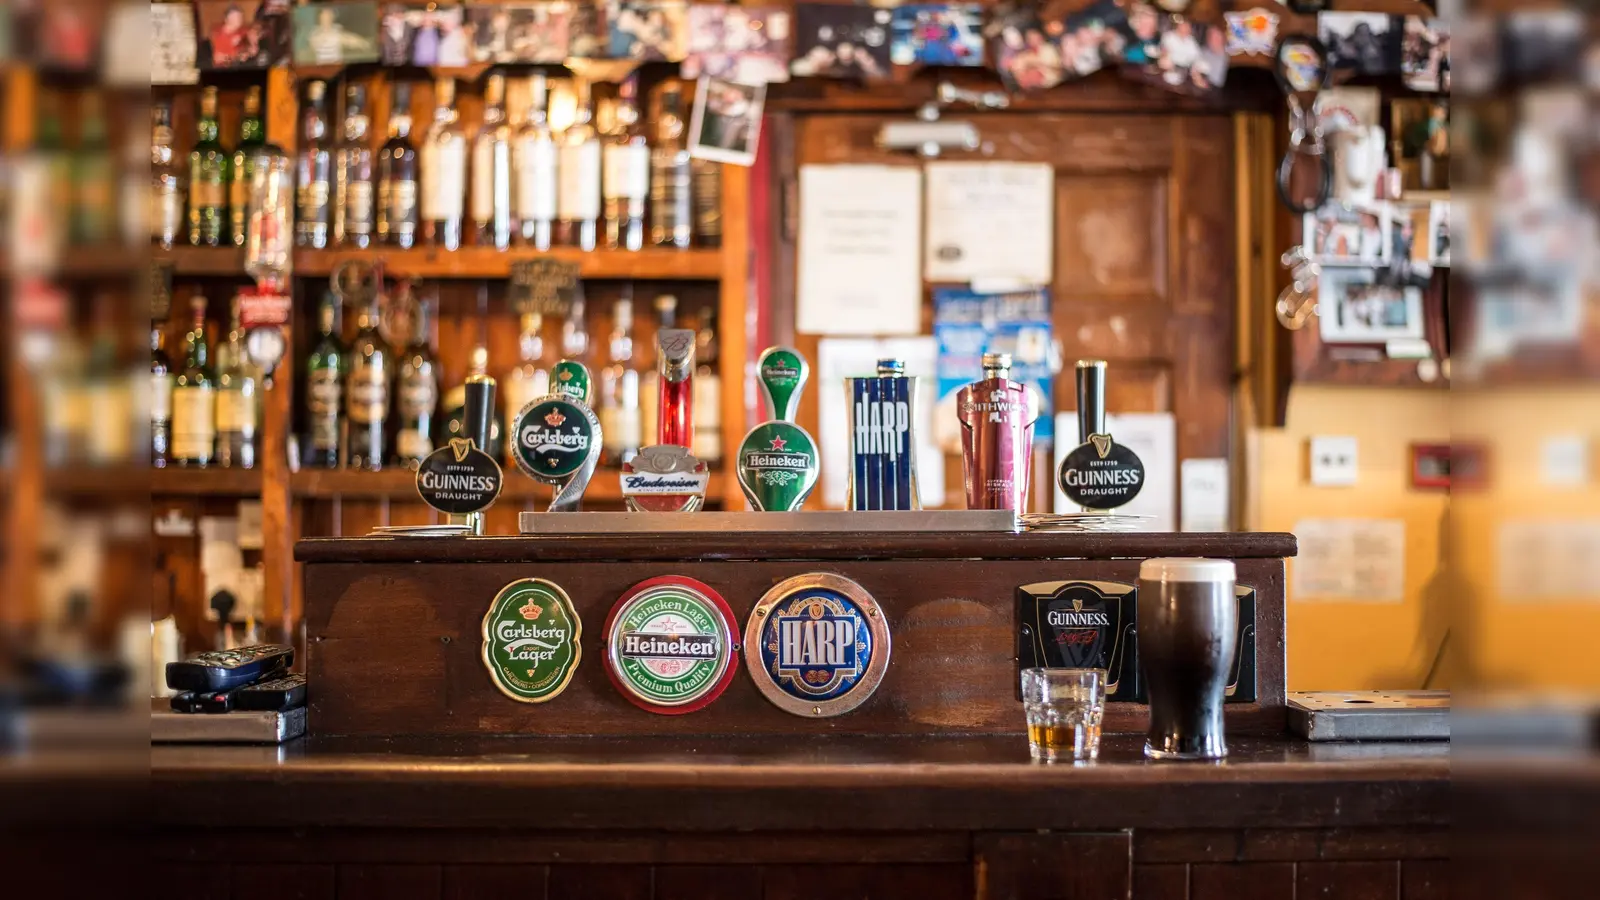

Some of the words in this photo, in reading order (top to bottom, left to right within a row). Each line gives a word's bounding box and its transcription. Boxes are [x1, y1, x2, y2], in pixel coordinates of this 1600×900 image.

[766, 368, 796, 376] Heineken
[856, 392, 909, 462] HARP
[521, 425, 588, 451] Carlsberg
[750, 455, 804, 468] Heineken
[423, 471, 494, 491] GUINNESS
[626, 476, 700, 488] Budweiser
[1065, 469, 1139, 486] GUINNESS
[435, 492, 482, 500] DRAUGHT
[628, 600, 682, 628] Heineken
[683, 603, 711, 631] Lager
[1048, 611, 1107, 625] GUINNESS
[497, 620, 565, 644] Carlsberg
[625, 636, 714, 655] Heineken
[781, 620, 854, 665] HARP
[508, 648, 555, 668] Lager
[504, 667, 528, 689] CARLSBERG
[628, 663, 673, 693] Premium
[674, 664, 711, 693] Quality
